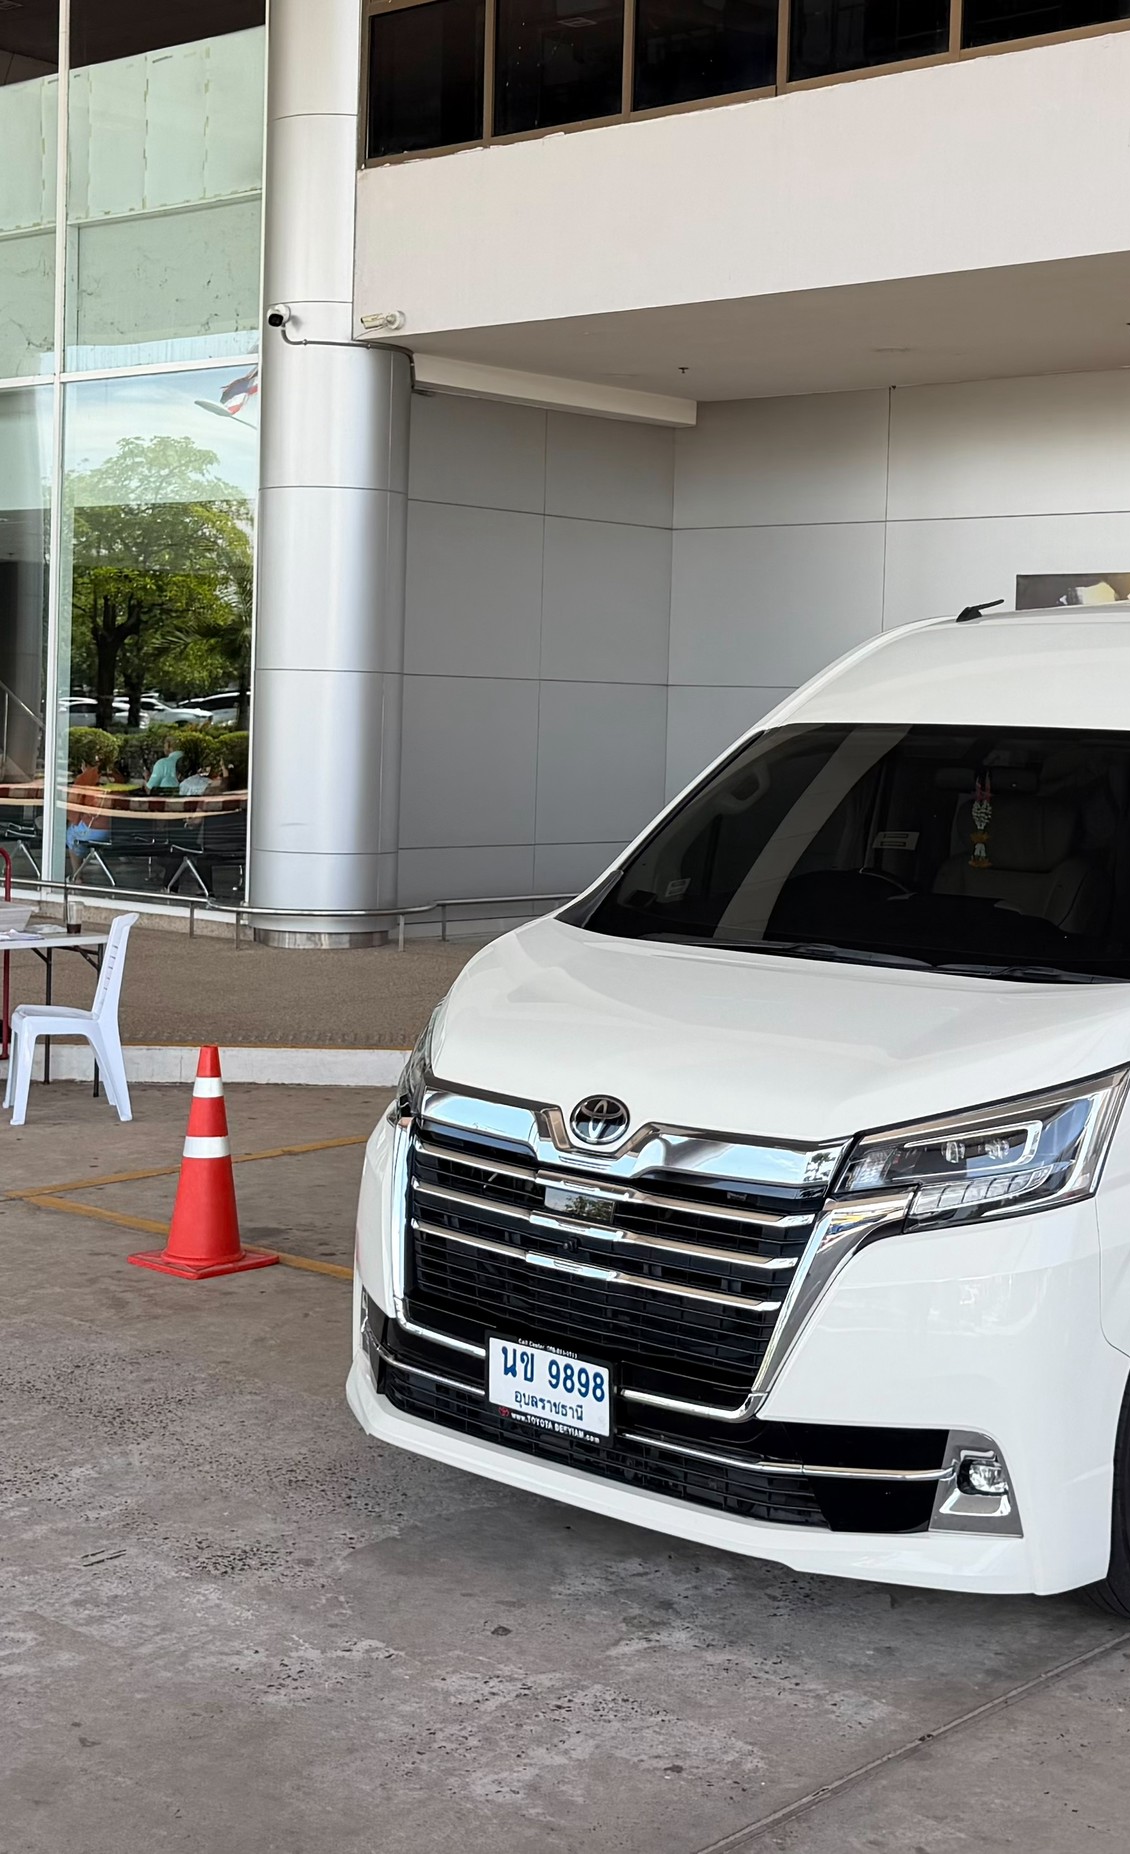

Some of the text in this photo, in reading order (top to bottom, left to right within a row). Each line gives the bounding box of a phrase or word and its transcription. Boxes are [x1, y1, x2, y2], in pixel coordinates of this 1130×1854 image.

[501, 1346, 605, 1403] นข 9898
[514, 1390, 584, 1422] อุบลราชธานี
